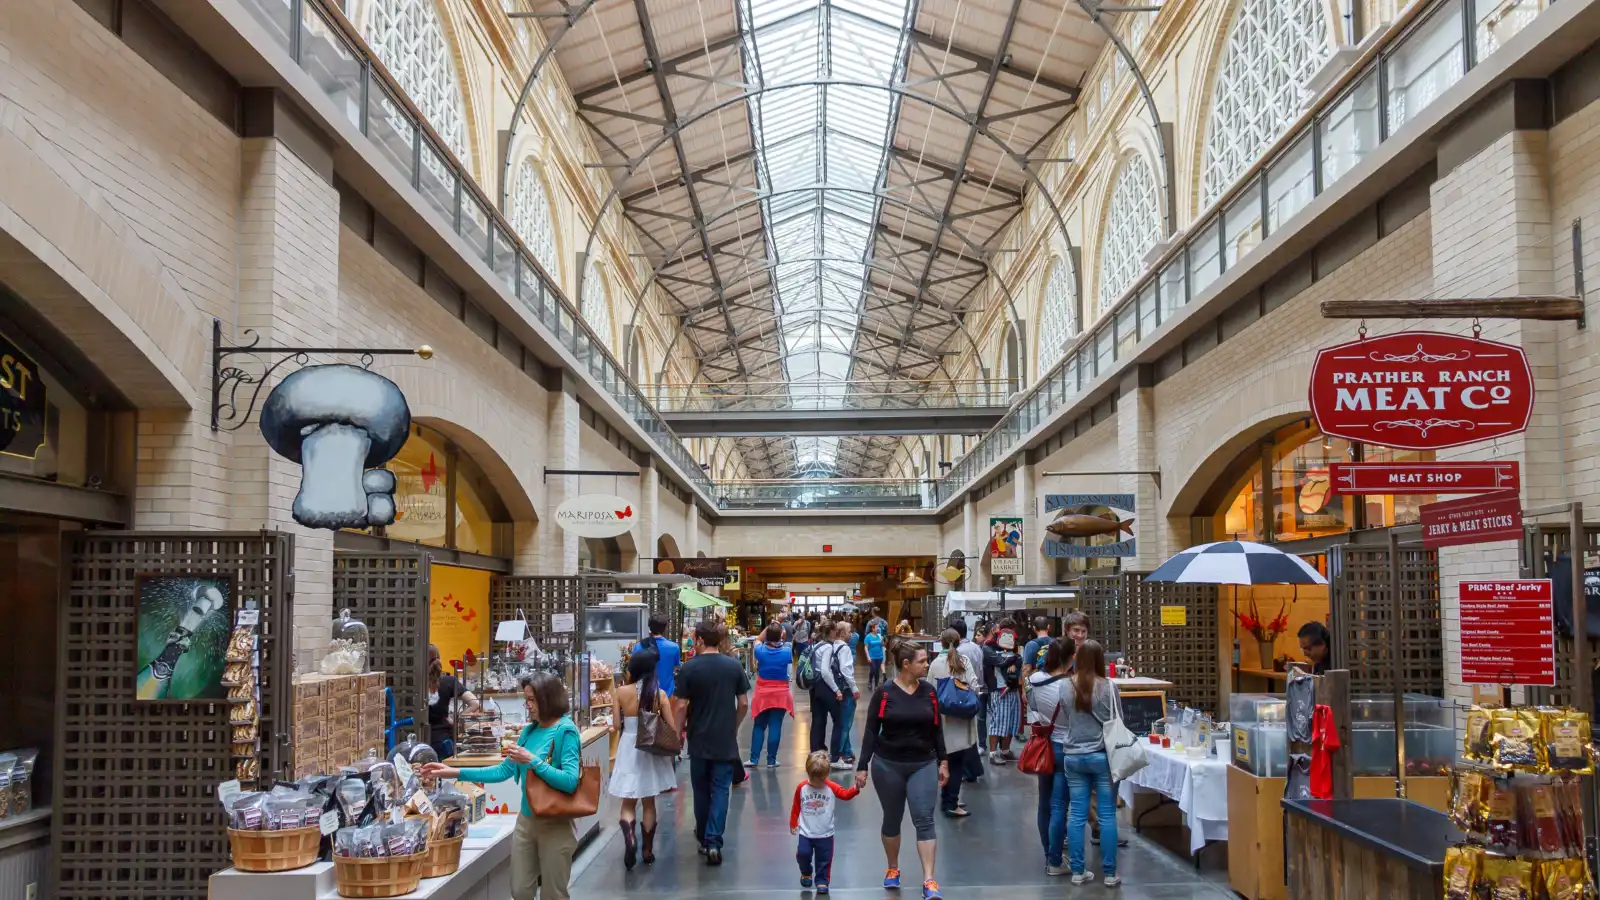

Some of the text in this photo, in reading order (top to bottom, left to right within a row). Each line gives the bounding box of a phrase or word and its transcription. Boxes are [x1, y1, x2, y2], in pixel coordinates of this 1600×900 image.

[1333, 370, 1511, 384] PRATHER RANCH
[1334, 386, 1452, 411] MEAT
[1389, 473, 1462, 483] MEAT SHOP
[1046, 495, 1134, 511] SAN FRANCISCO
[557, 510, 614, 520] MARIPOSA
[1428, 515, 1513, 536] JERKY & MEAT STICKS
[1048, 539, 1074, 557] FISH
[1495, 583, 1514, 591] Beef
[1516, 583, 1542, 592] Jerky
